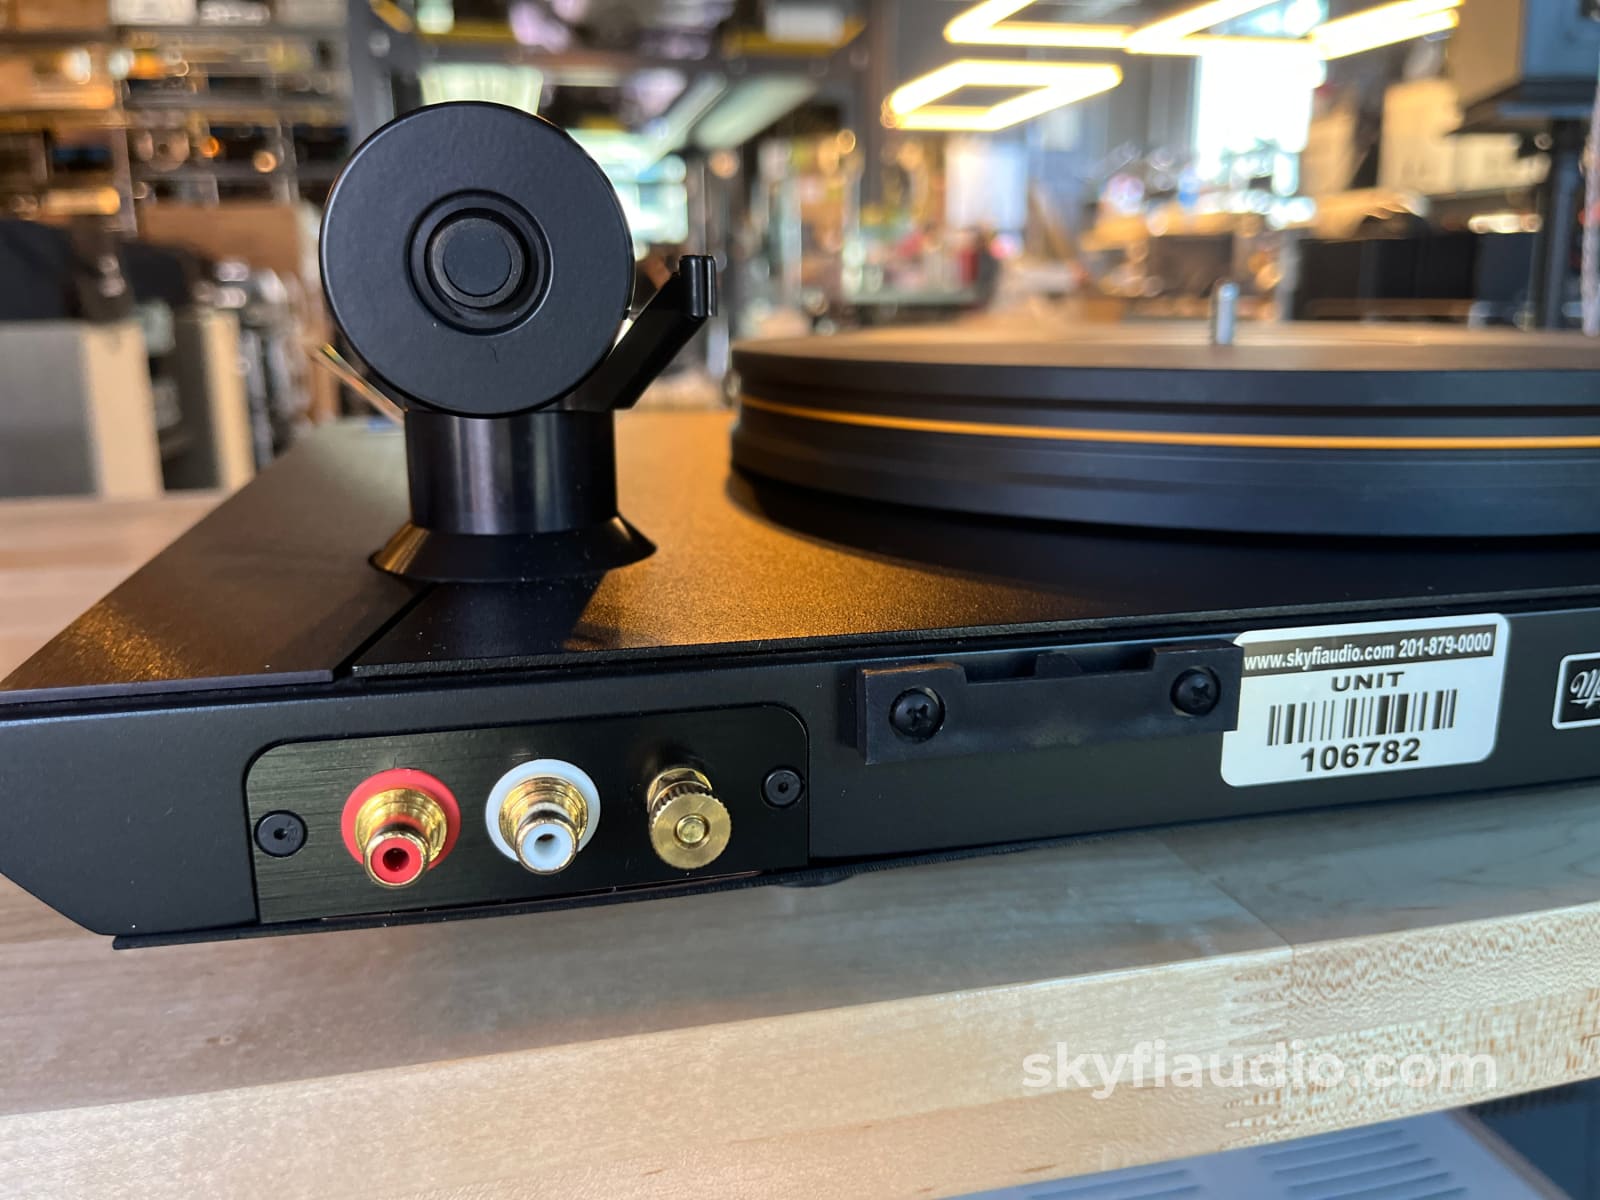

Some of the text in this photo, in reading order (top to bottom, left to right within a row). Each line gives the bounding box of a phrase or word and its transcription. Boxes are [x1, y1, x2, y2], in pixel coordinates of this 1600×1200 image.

[1244, 632, 1491, 671] www.skyfiaudio.com 201-879-0000
[1331, 671, 1404, 692] UNIT
[1301, 738, 1421, 772] 106782
